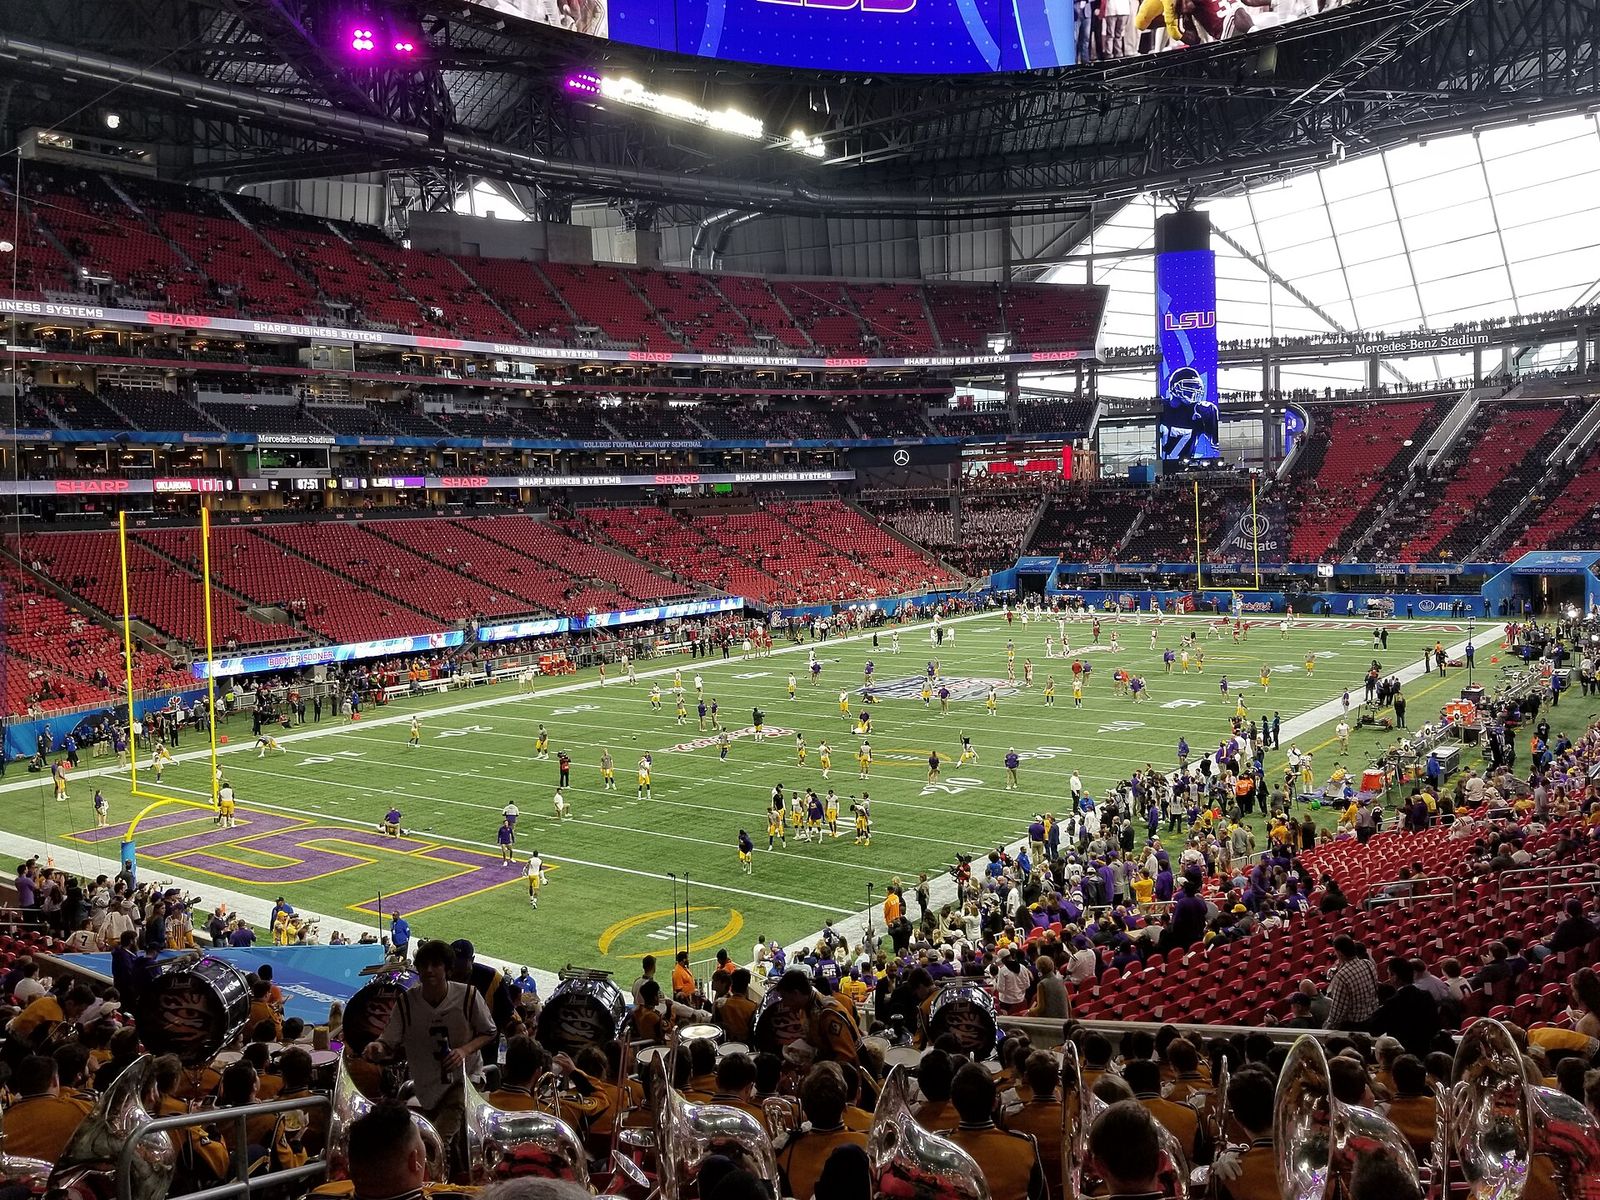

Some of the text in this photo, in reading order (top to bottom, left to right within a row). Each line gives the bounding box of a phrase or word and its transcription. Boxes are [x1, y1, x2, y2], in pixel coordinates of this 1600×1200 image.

[0, 300, 103, 318] INESS SYSTEMS
[147, 312, 211, 327] SHARP
[1165, 311, 1215, 331] LSU
[253, 322, 382, 342] SHARP BUSINESS SYSTEMS
[1355, 334, 1489, 354] Mercedes-Benz Stadium
[494, 344, 599, 358] SHARP BUSINESS SYSTEMS
[628, 352, 672, 361] SHARP
[1031, 351, 1078, 361] SHARP
[702, 354, 798, 365] SHARP BUSINESS SYSTEMS
[825, 358, 868, 366] SHARP
[931, 357, 971, 366] BUSINESS
[973, 355, 1010, 364] SYSTEMS
[258, 434, 336, 444] Mercedes-Benz Stadium
[519, 478, 543, 486] SHARP
[583, 477, 621, 485] SYSTEMS
[655, 474, 699, 484] SHARP
[762, 473, 797, 481] BUSINESS
[800, 472, 831, 480] SYSTEMS
[56, 480, 128, 492] SHARP
[442, 478, 488, 487] SHARP
[1231, 536, 1277, 551] Allsate
[1435, 602, 1472, 611] Allse
[268, 650, 333, 667] BOOMER SOONER
[295, 750, 367, 766] 10
[919, 776, 985, 797] 20
[60, 805, 560, 918] LSU
[81, 935, 88, 946] 7
